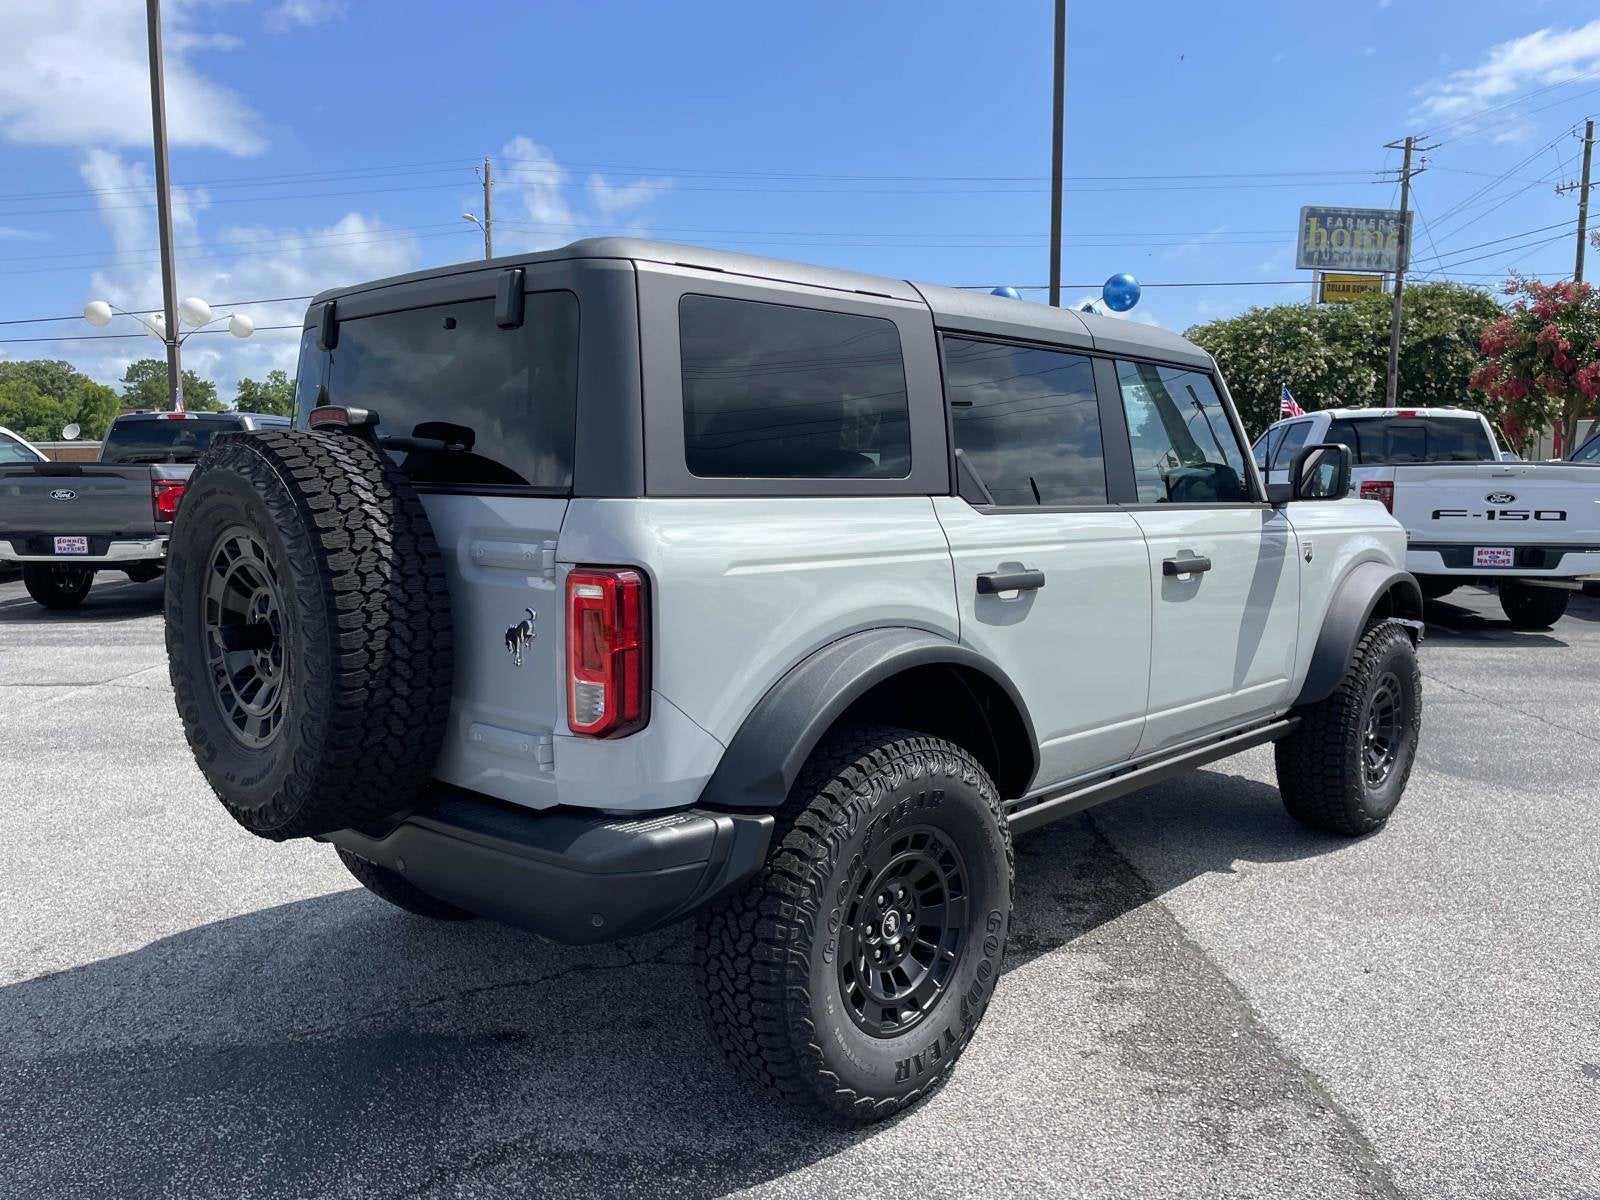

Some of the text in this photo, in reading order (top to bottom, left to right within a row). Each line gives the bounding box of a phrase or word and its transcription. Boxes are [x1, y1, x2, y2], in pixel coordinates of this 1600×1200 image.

[1326, 216, 1396, 231] FARMERS
[1326, 283, 1382, 294] DOLLAR GENEAL
[53, 490, 72, 499] Ford
[1488, 494, 1513, 503] Ford
[1431, 509, 1567, 521] F-150
[893, 908, 1003, 1084] GOODYEAR
